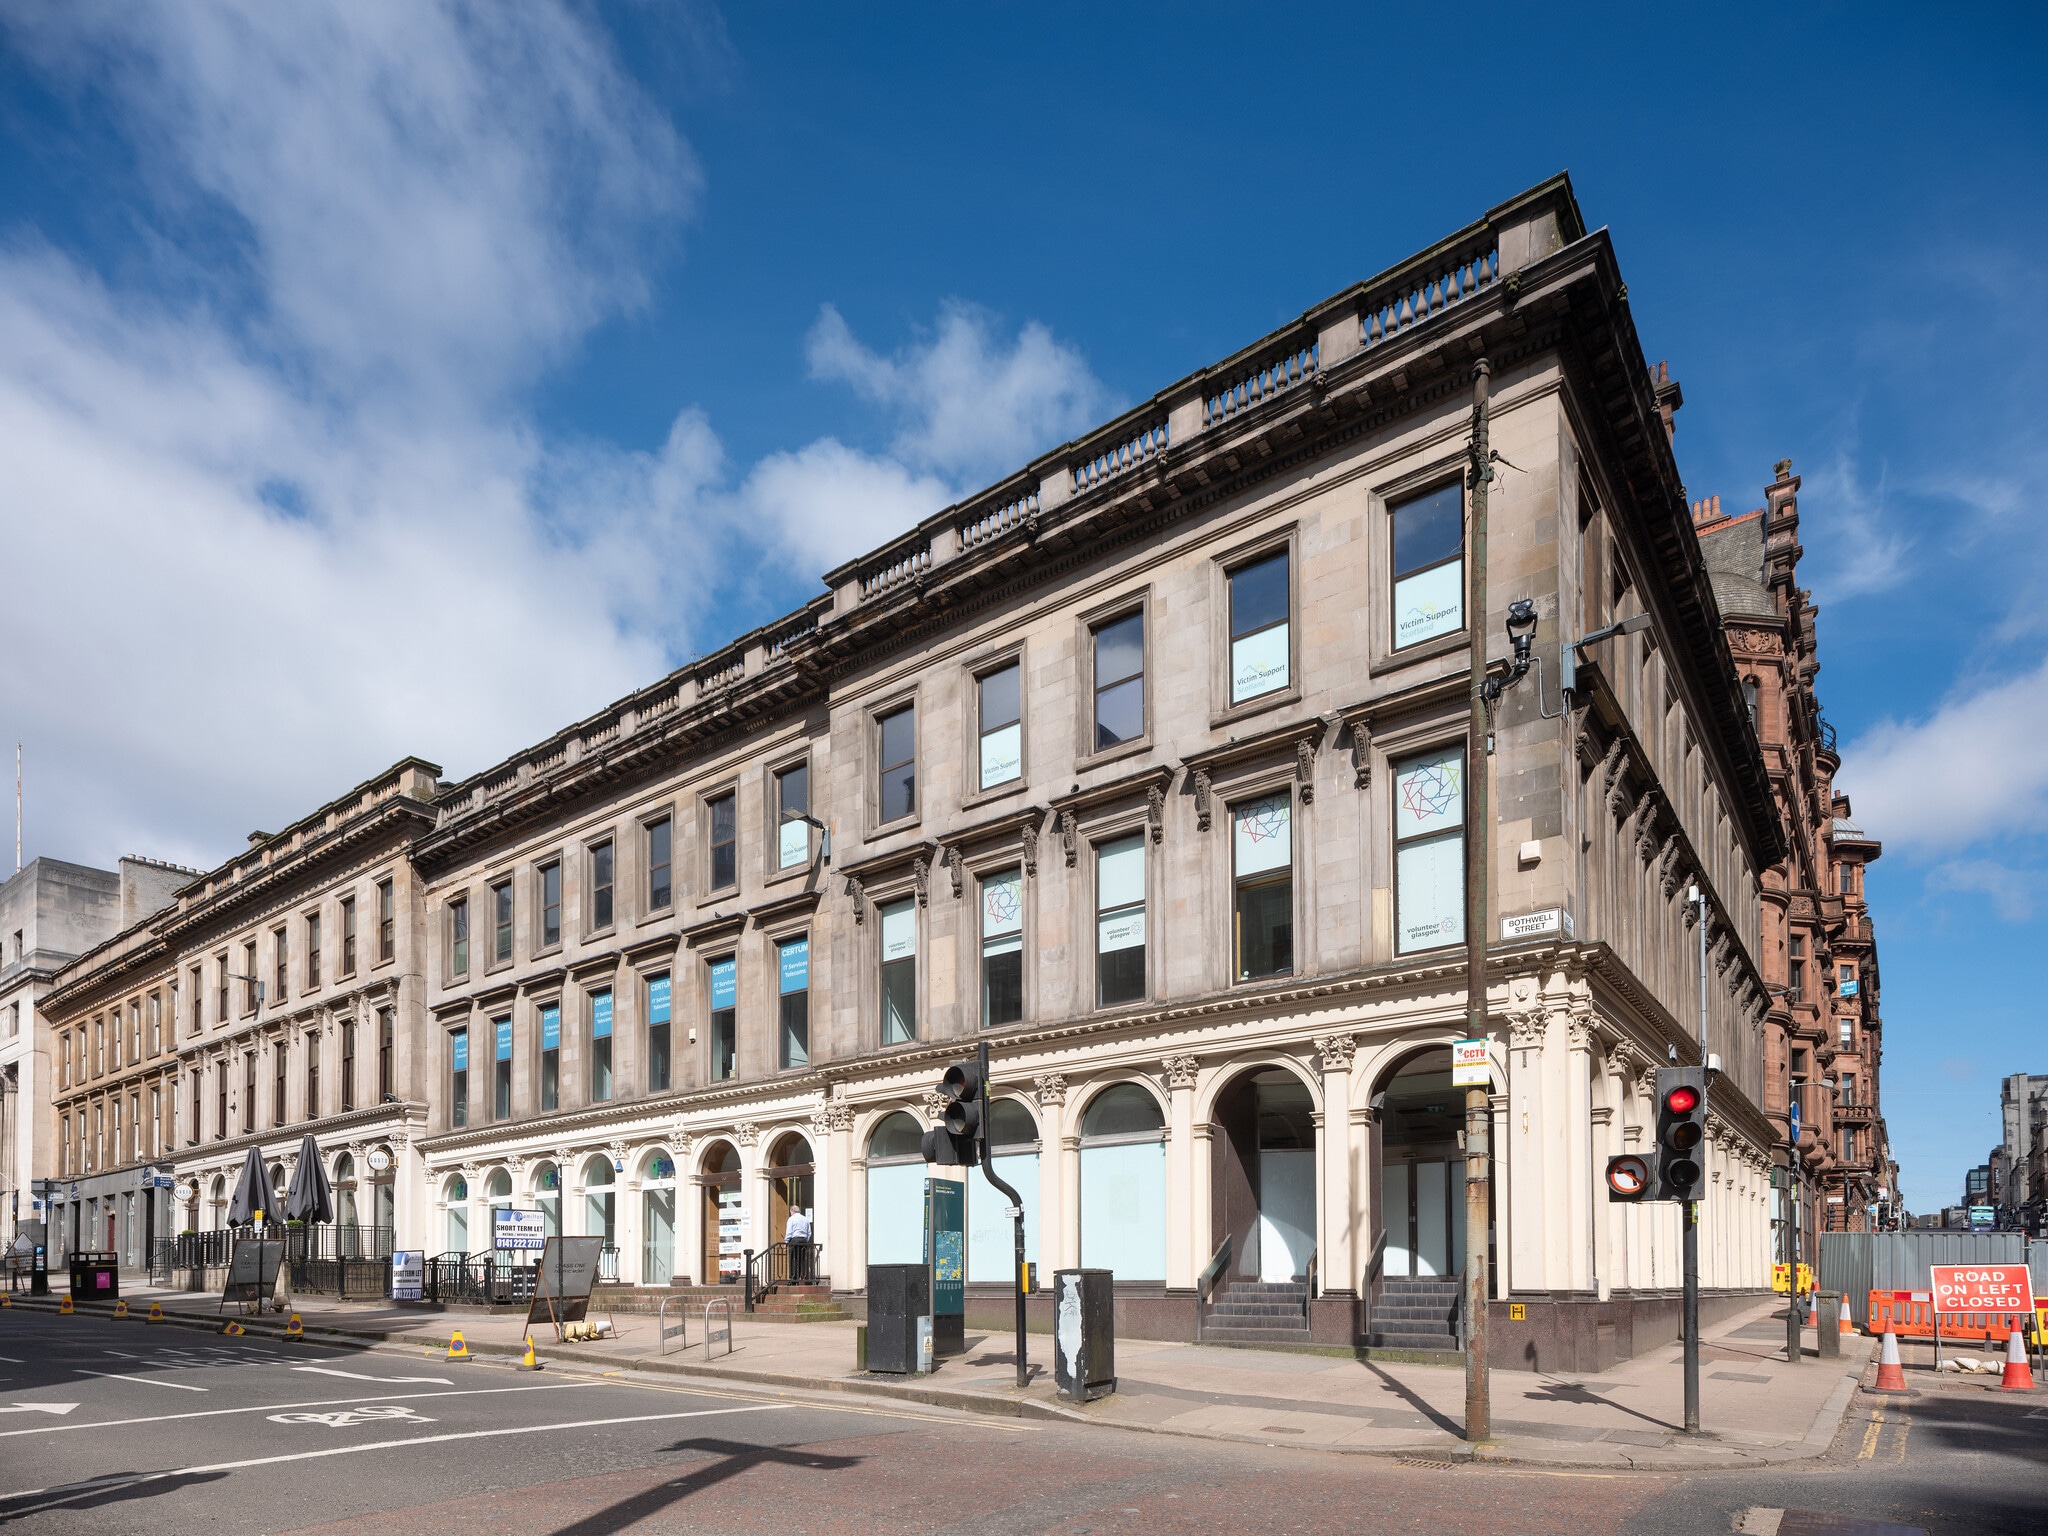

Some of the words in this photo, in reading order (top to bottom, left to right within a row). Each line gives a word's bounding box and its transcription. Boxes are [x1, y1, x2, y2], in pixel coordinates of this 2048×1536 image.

[1400, 617, 1424, 630] Victim
[1425, 605, 1457, 621] Support
[1400, 622, 1434, 640] Scotland
[1236, 674, 1258, 686] Victim
[1258, 664, 1286, 679] Support
[1236, 679, 1266, 694] Scotland
[984, 765, 999, 774] Victim
[1000, 758, 1020, 770] Support
[1508, 913, 1554, 928] BOTHWELL
[1106, 926, 1131, 935] volunteer
[1406, 923, 1440, 933] volunteer
[1514, 922, 1547, 934] STREET
[1109, 931, 1131, 940] glasgow
[1410, 929, 1440, 939] glasgow
[781, 943, 808, 957] CERTUM
[788, 960, 808, 970] Services
[784, 968, 806, 978] Telecoms
[715, 987, 735, 995] Telecoms
[1463, 1048, 1486, 1058] CCTV
[496, 1238, 513, 1248] 0141
[513, 1239, 527, 1248] 222
[528, 1239, 543, 1248] 2777
[1954, 1271, 2005, 1282] ROAD
[393, 1288, 403, 1299] 0141
[403, 1288, 411, 1299] 222
[412, 1288, 422, 1299] 2777
[1940, 1284, 1967, 1295] ON
[1978, 1283, 2023, 1294] LEFT
[1946, 1297, 2021, 1307] CLOSED
[1512, 1305, 1523, 1318] H
[102, 1346, 278, 1359] LEFT
[140, 1355, 344, 1369] TURN
